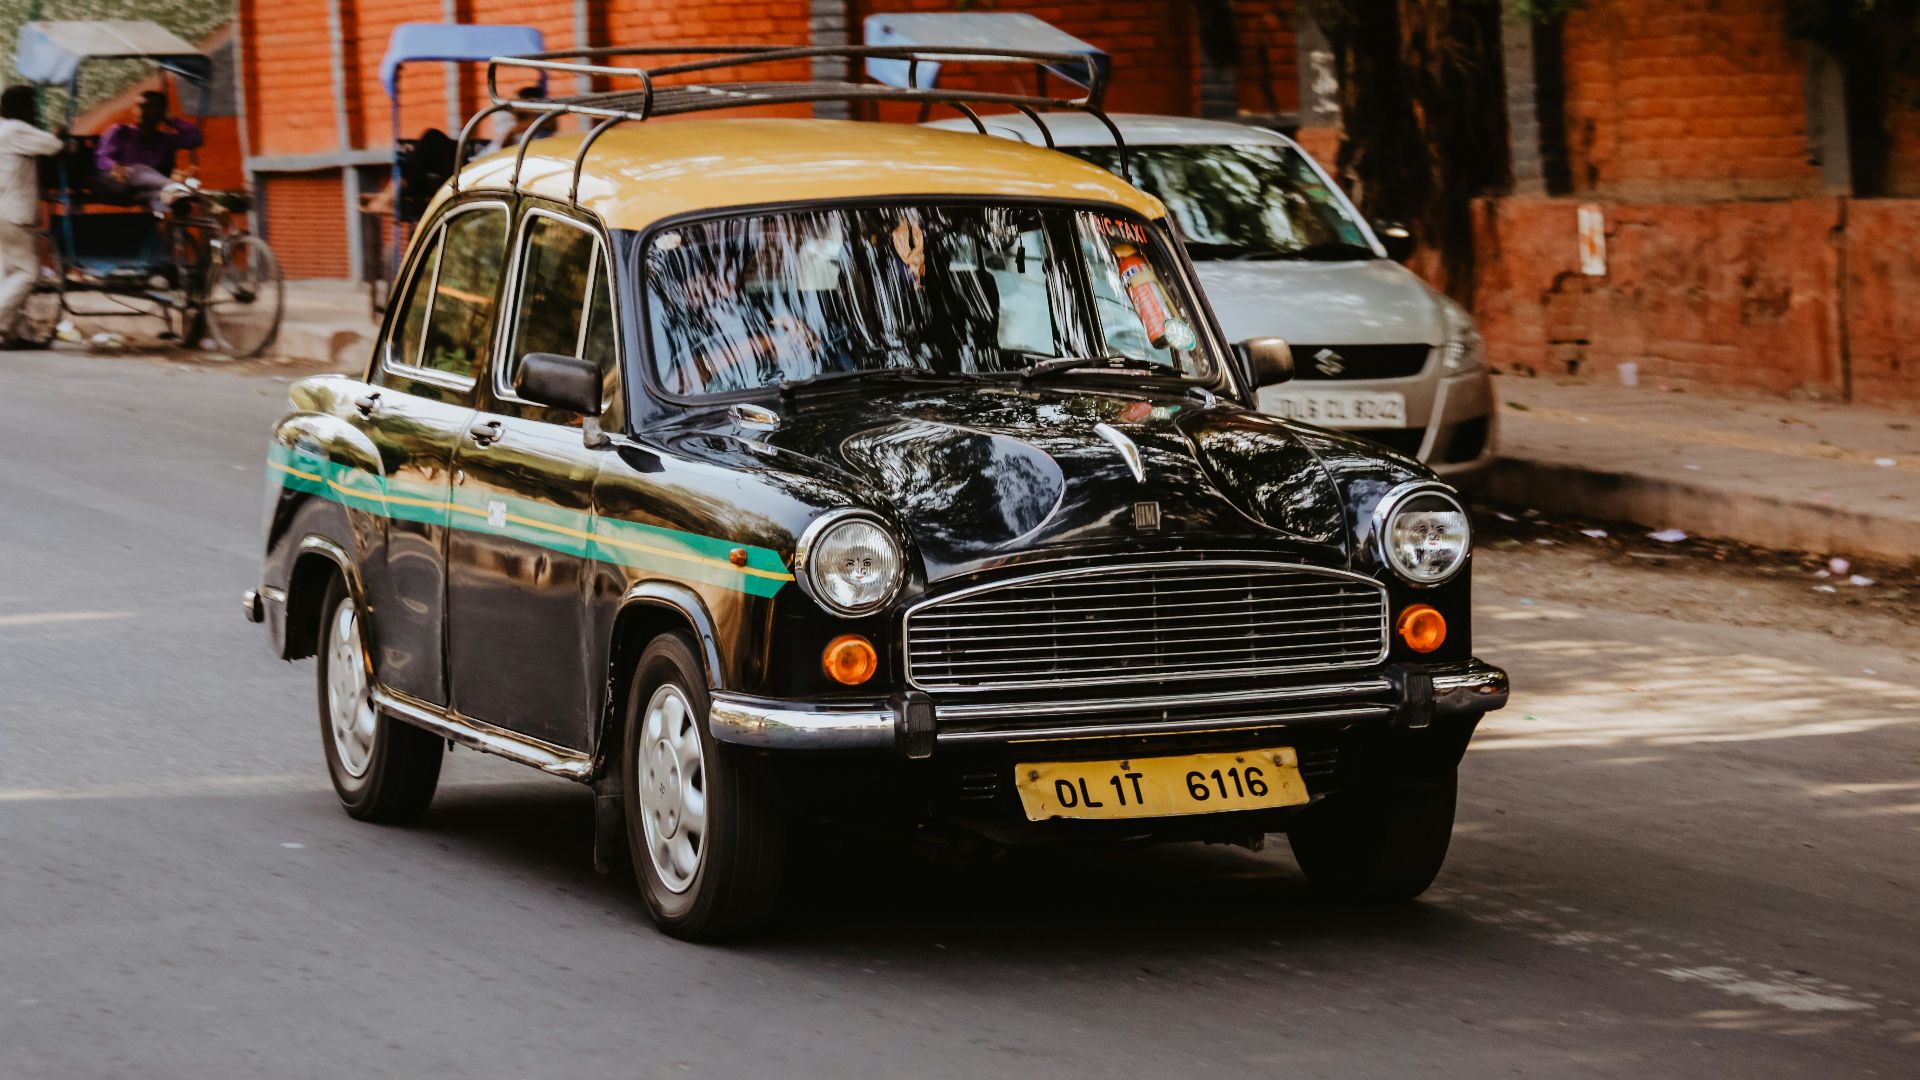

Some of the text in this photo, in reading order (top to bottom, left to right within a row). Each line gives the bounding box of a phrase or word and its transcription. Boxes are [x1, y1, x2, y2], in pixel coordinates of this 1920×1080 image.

[1115, 219, 1148, 244] TAXI
[1137, 505, 1156, 526] HM
[1055, 766, 1269, 808] DL 1T 6116
